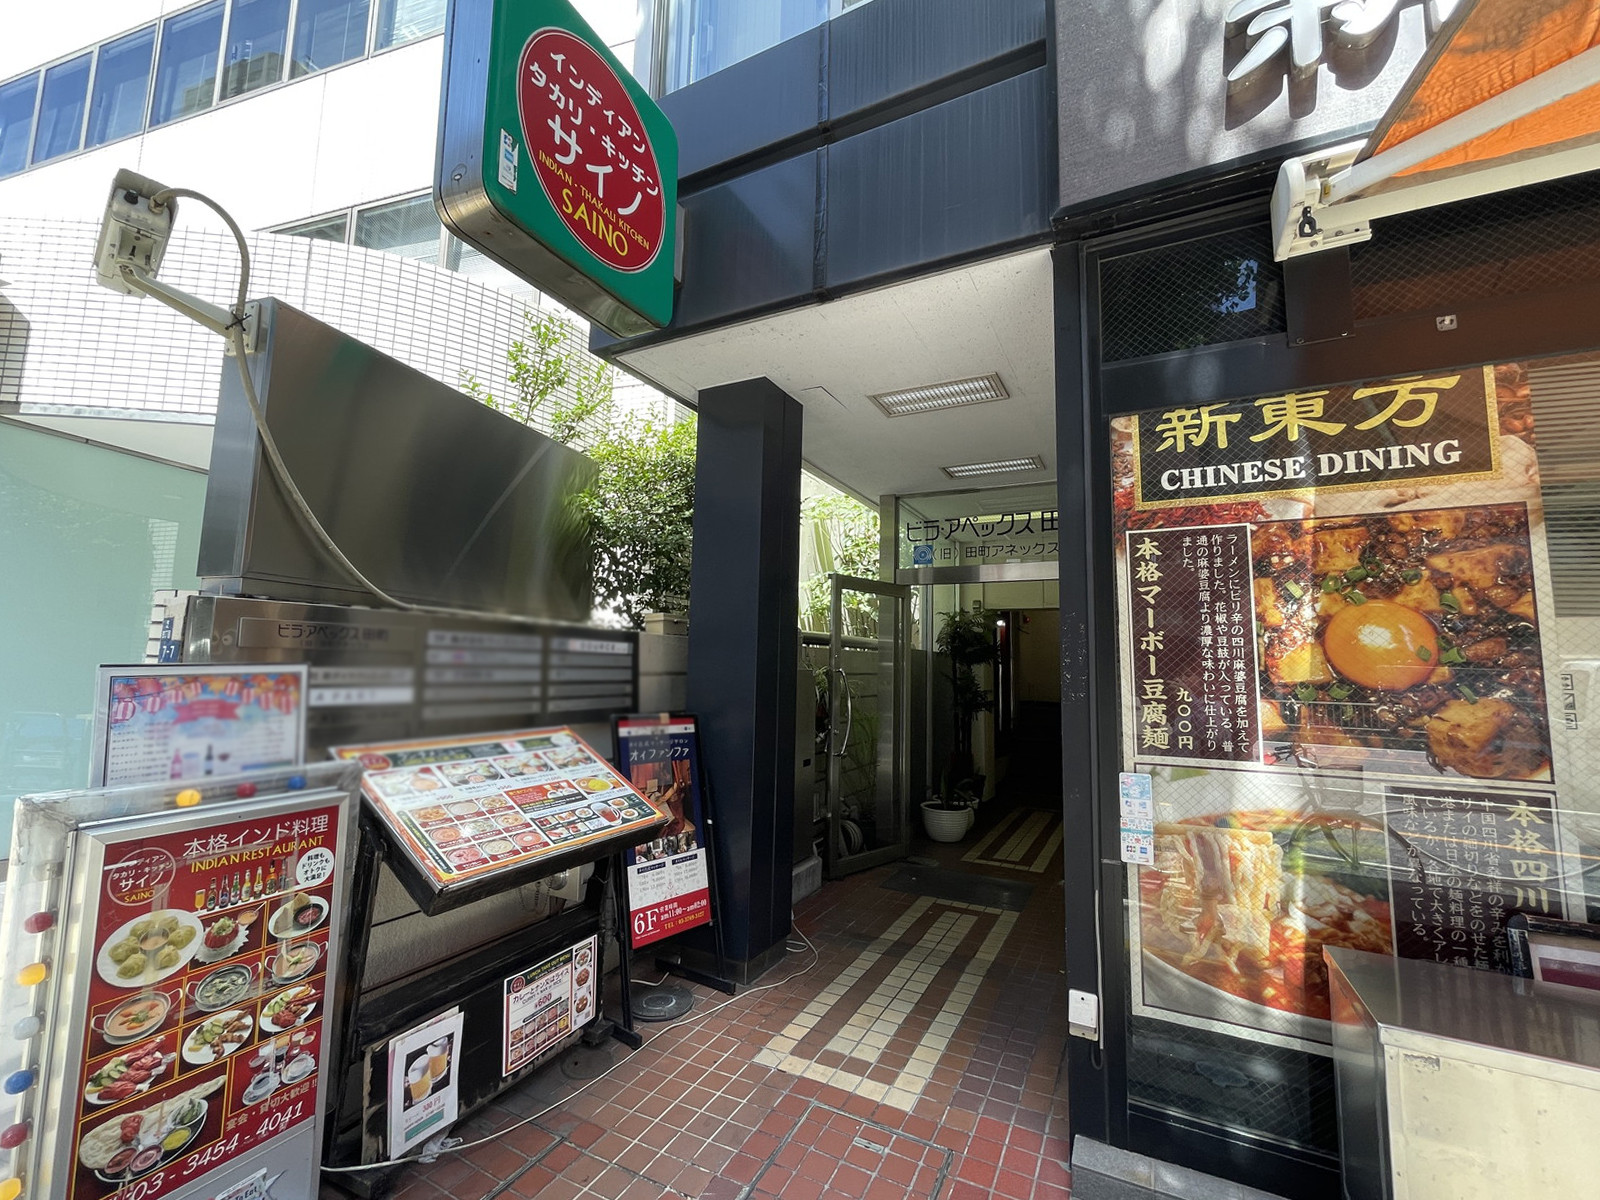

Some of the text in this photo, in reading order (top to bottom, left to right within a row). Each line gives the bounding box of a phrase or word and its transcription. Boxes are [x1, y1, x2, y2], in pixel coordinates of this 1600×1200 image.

[529, 61, 659, 196] タカリ・キッチン
[549, 51, 646, 154] インディアン
[547, 113, 642, 216] サイノ
[538, 149, 572, 187] INDIAN
[580, 184, 617, 223] THAKALI
[618, 217, 651, 251] KITCHEN
[561, 187, 629, 257] SAINO
[1155, 374, 1461, 454] 新東方
[1160, 438, 1463, 491] CHINESE DINING
[1182, 535, 1196, 572] ました。
[1134, 537, 1171, 751] 本格マーボー豆腐麺
[182, 814, 329, 858] 本格インド料理
[190, 835, 325, 873] INDIAN RESTAURANT
[1504, 799, 1550, 914] 本格四川
[119, 872, 164, 892] サイノ
[124, 889, 155, 903] SAINO
[633, 908, 660, 936] 6F
